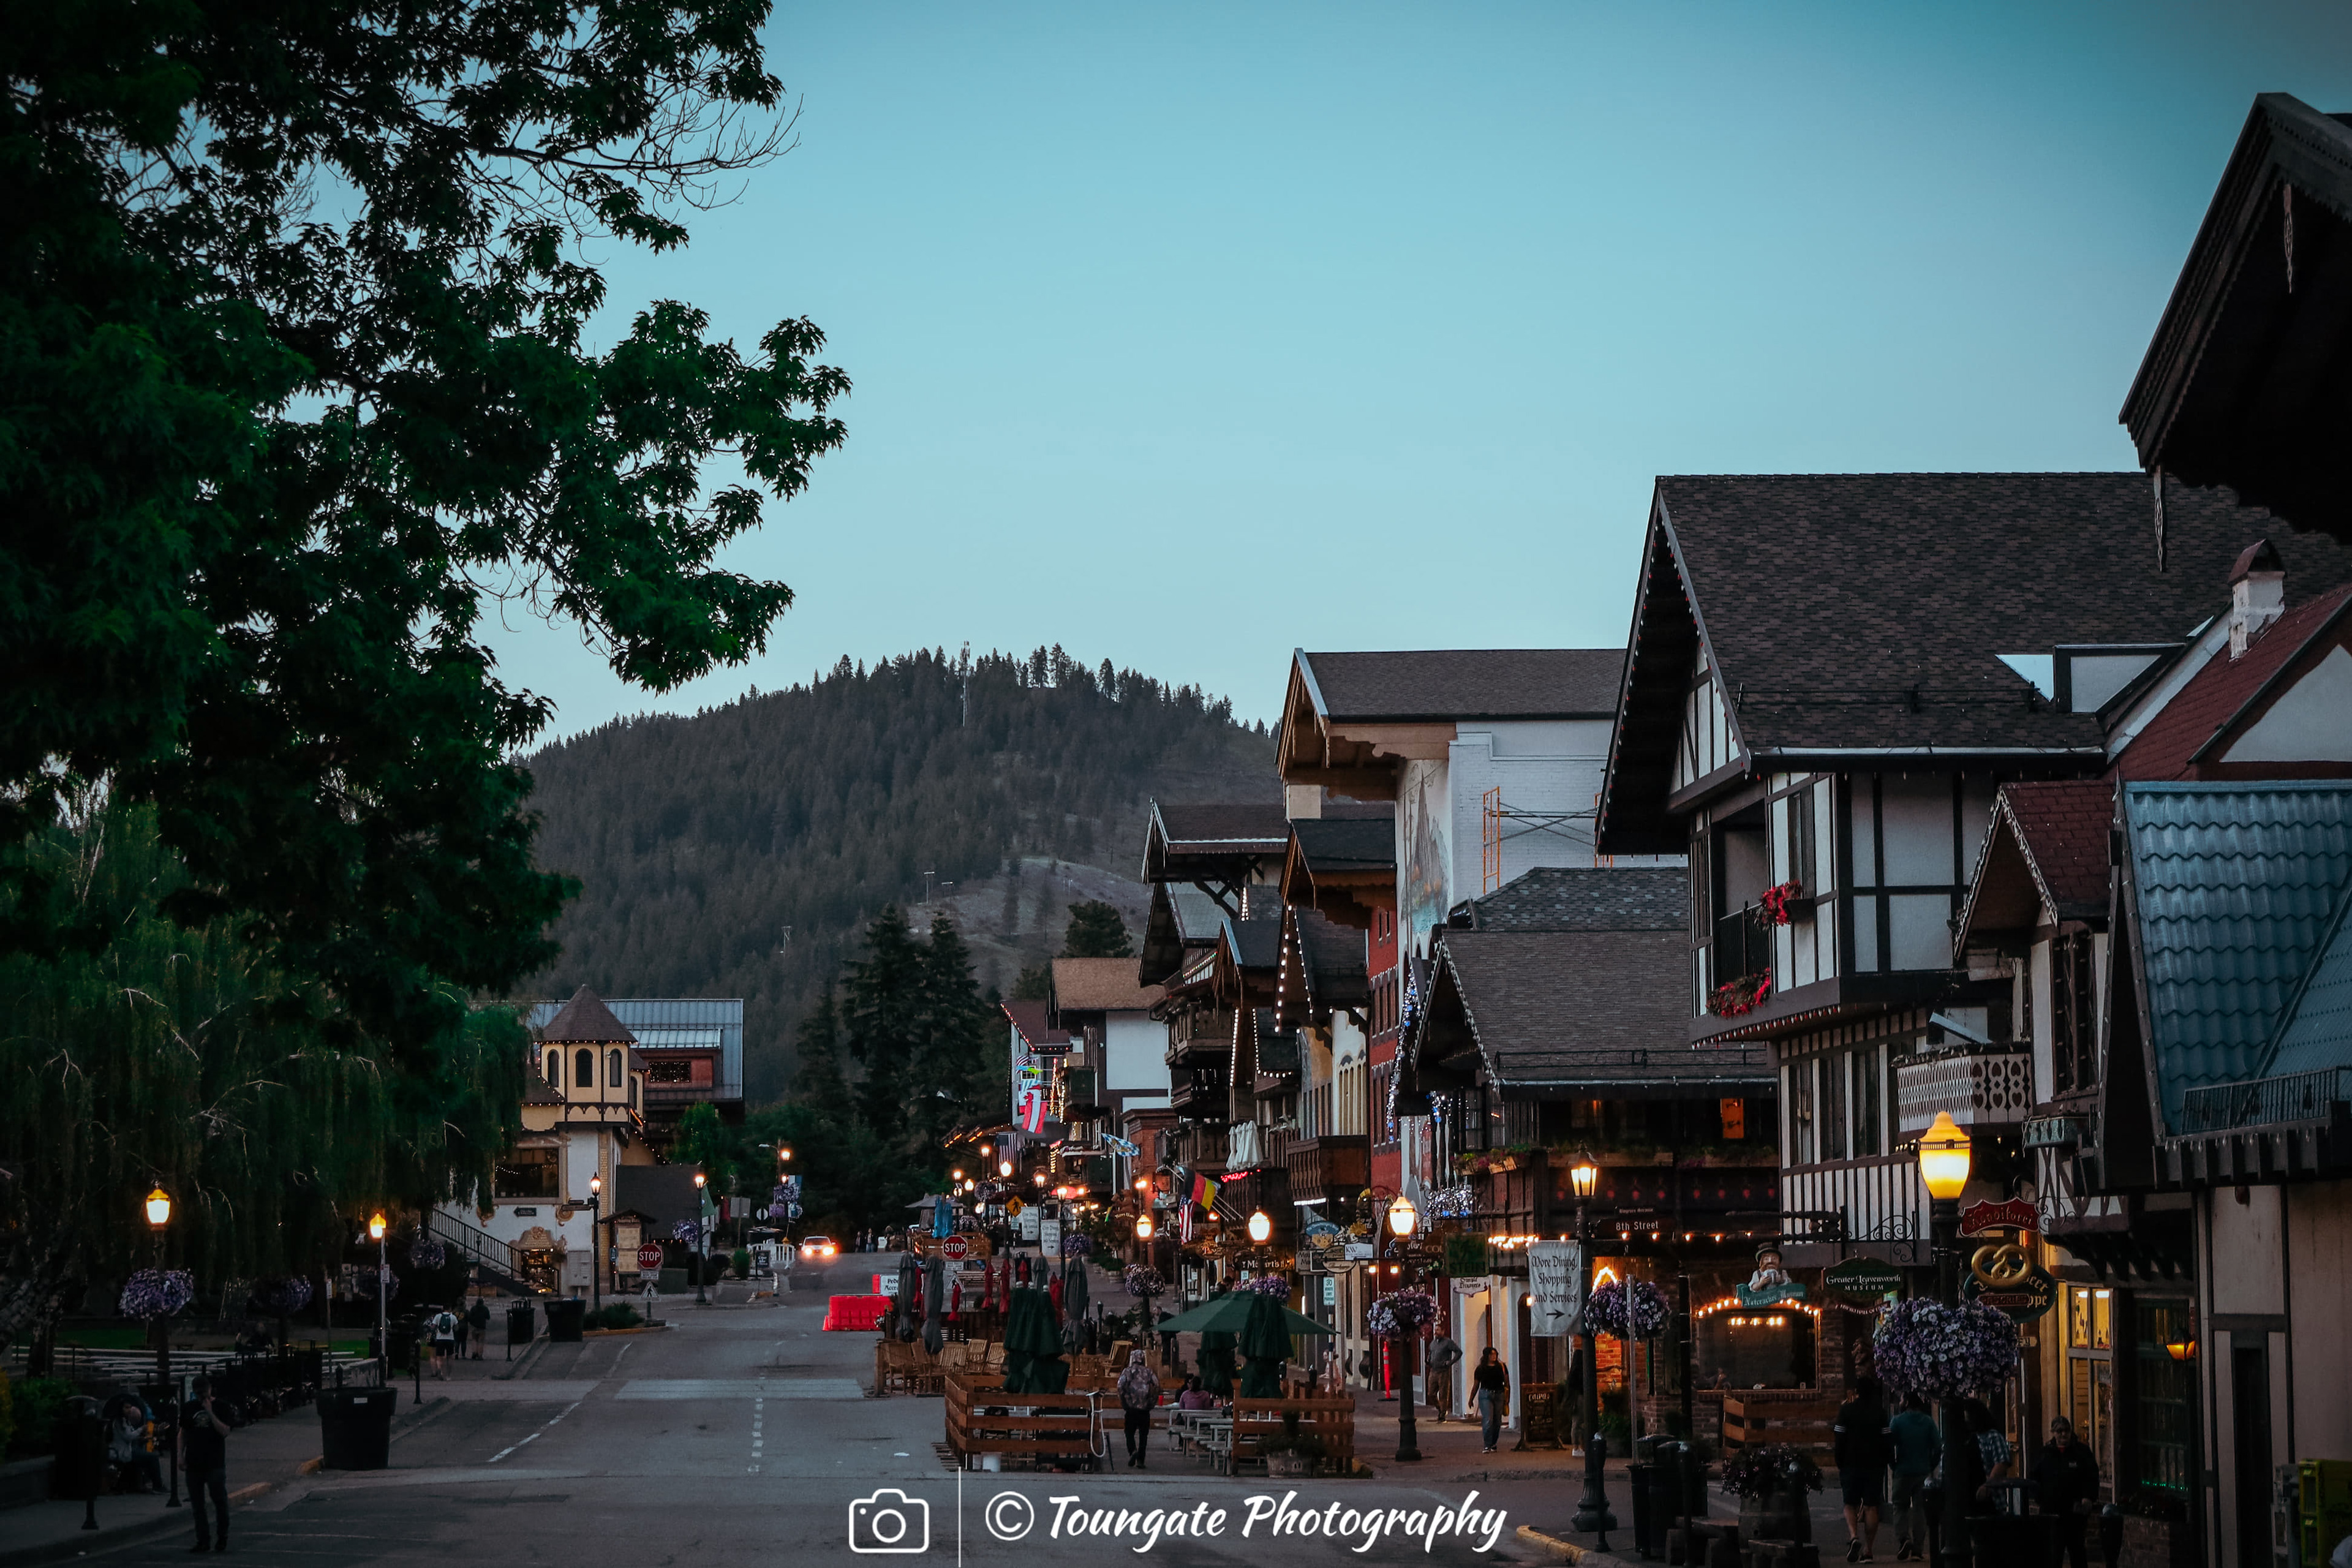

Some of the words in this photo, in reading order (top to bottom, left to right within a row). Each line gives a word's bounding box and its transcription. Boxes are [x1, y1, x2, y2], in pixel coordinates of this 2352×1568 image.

[1615, 1223, 1630, 1231] 8th
[1634, 1220, 1659, 1229] Street
[639, 1251, 660, 1261] STOP
[1532, 1256, 1551, 1268] More
[1539, 1273, 1572, 1287] Shopping
[1826, 1276, 1855, 1285] Greater
[1856, 1275, 1901, 1286] Leavenworth
[1534, 1292, 1548, 1303] and
[1550, 1292, 1577, 1303] Services
